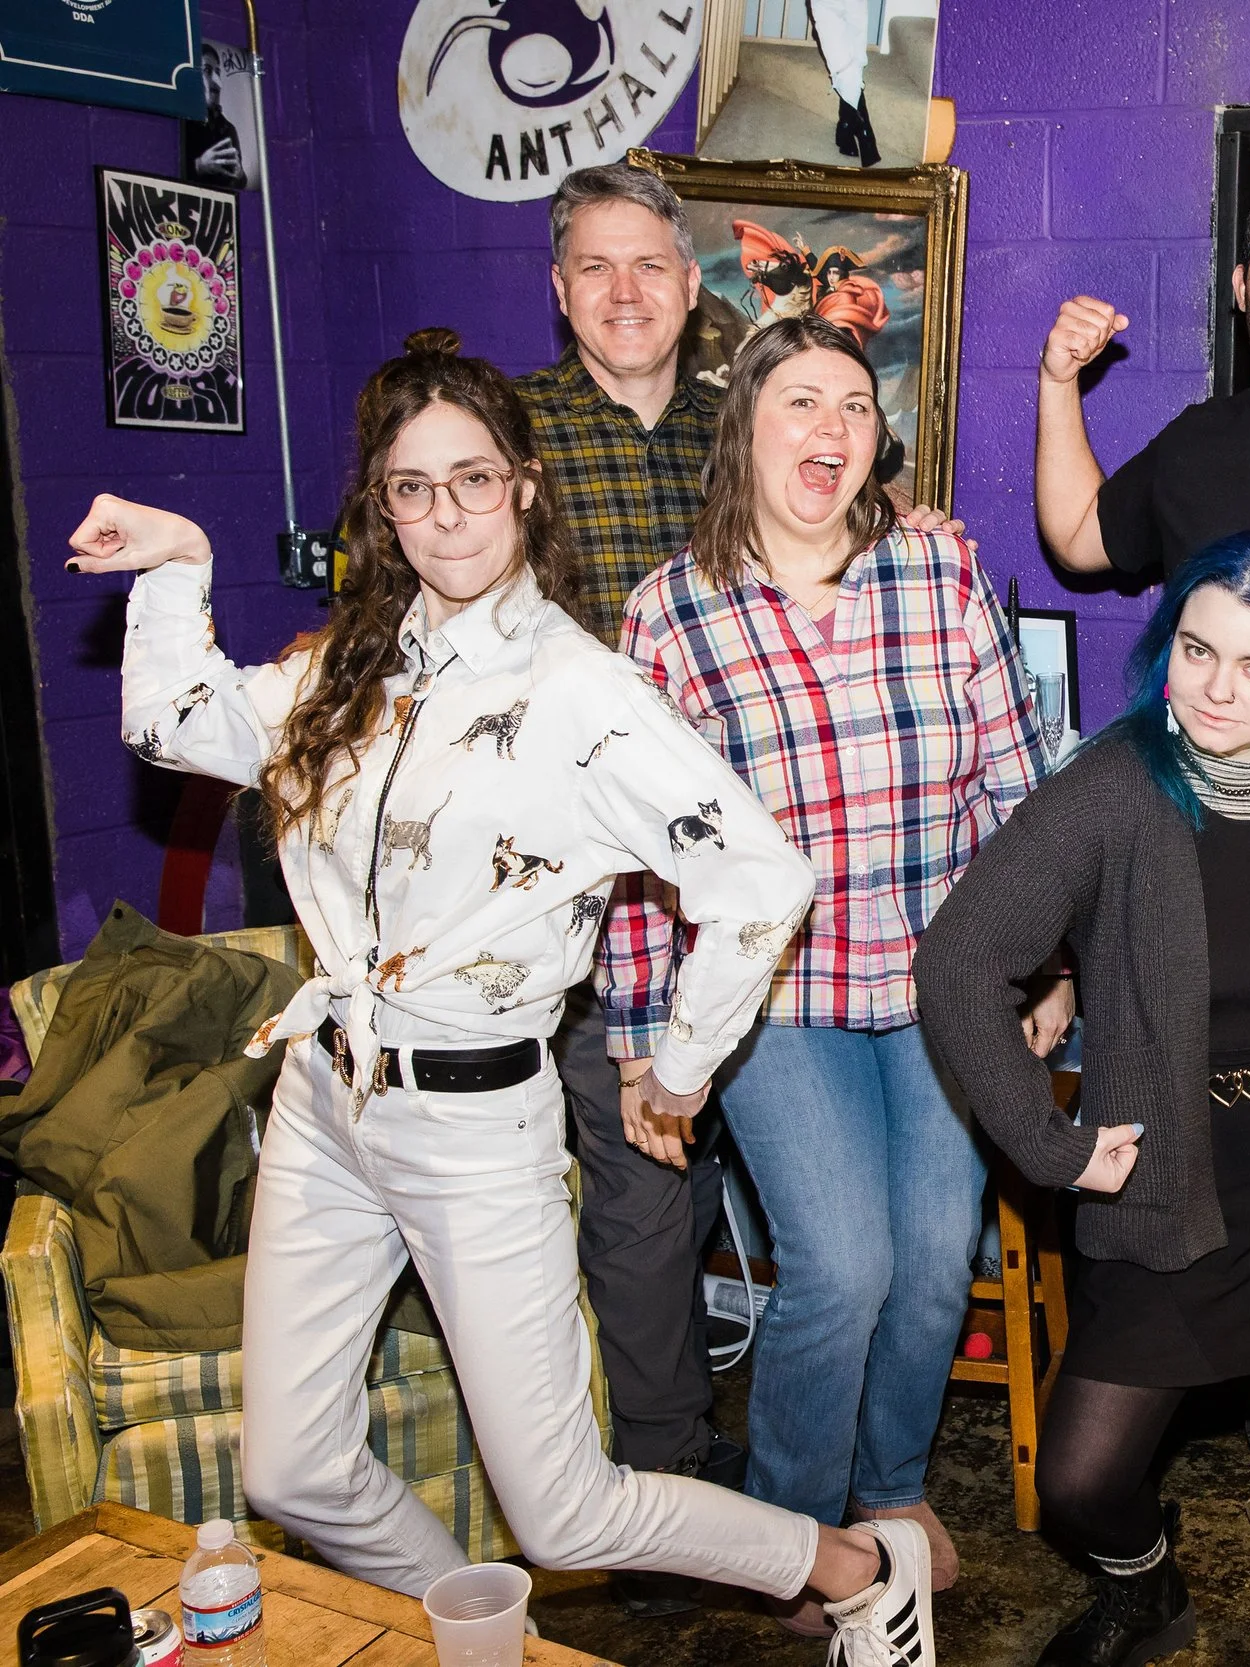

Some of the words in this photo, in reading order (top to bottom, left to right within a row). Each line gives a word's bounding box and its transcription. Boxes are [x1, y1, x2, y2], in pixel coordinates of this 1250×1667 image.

[72, 11, 95, 24] DDA
[484, 6, 692, 181] ANTHALL
[166, 224, 184, 236] ON
[227, 1599, 254, 1618] CRYSTAL
[842, 1603, 867, 1617] adidas
